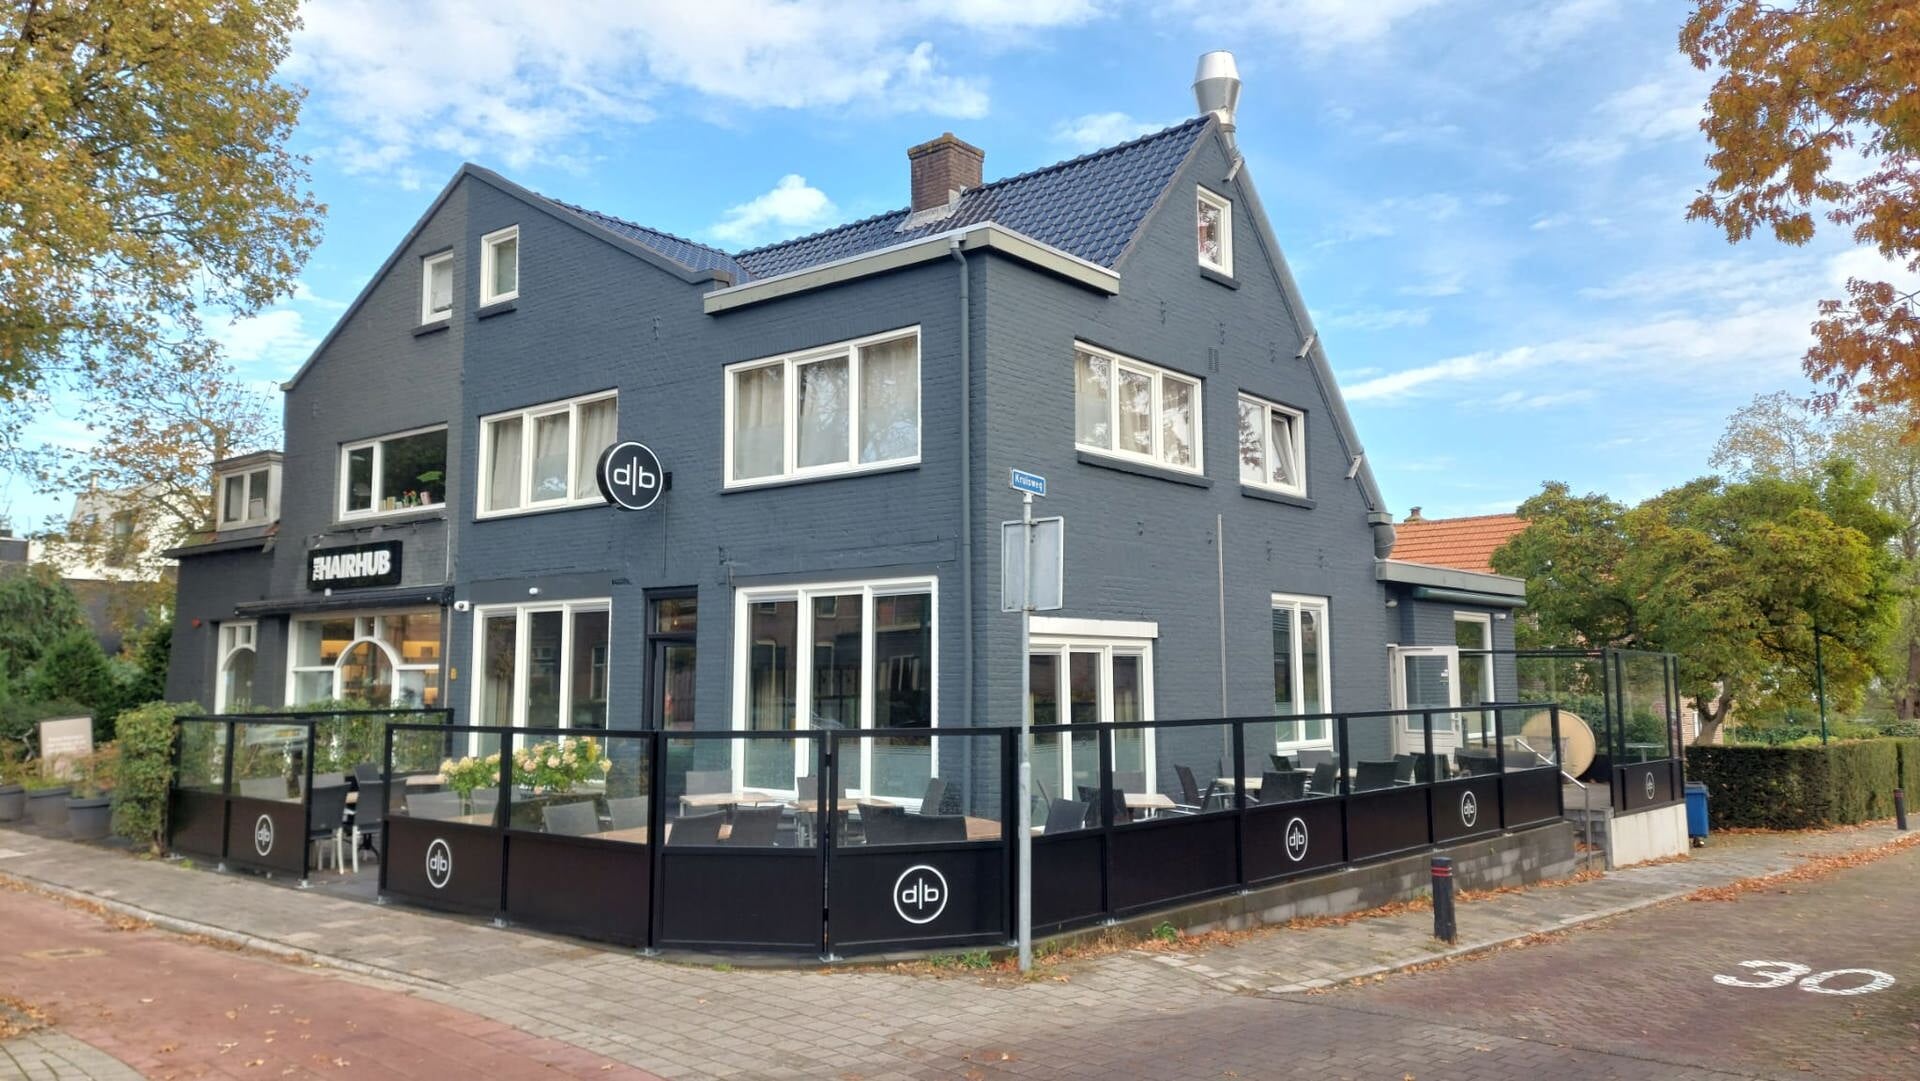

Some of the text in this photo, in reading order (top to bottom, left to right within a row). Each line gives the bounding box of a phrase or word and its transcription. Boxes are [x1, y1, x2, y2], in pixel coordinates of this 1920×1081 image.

[1014, 472, 1043, 492] Kruisweg
[312, 550, 392, 581] THE HAIRHUB
[1712, 960, 1896, 995] 30
